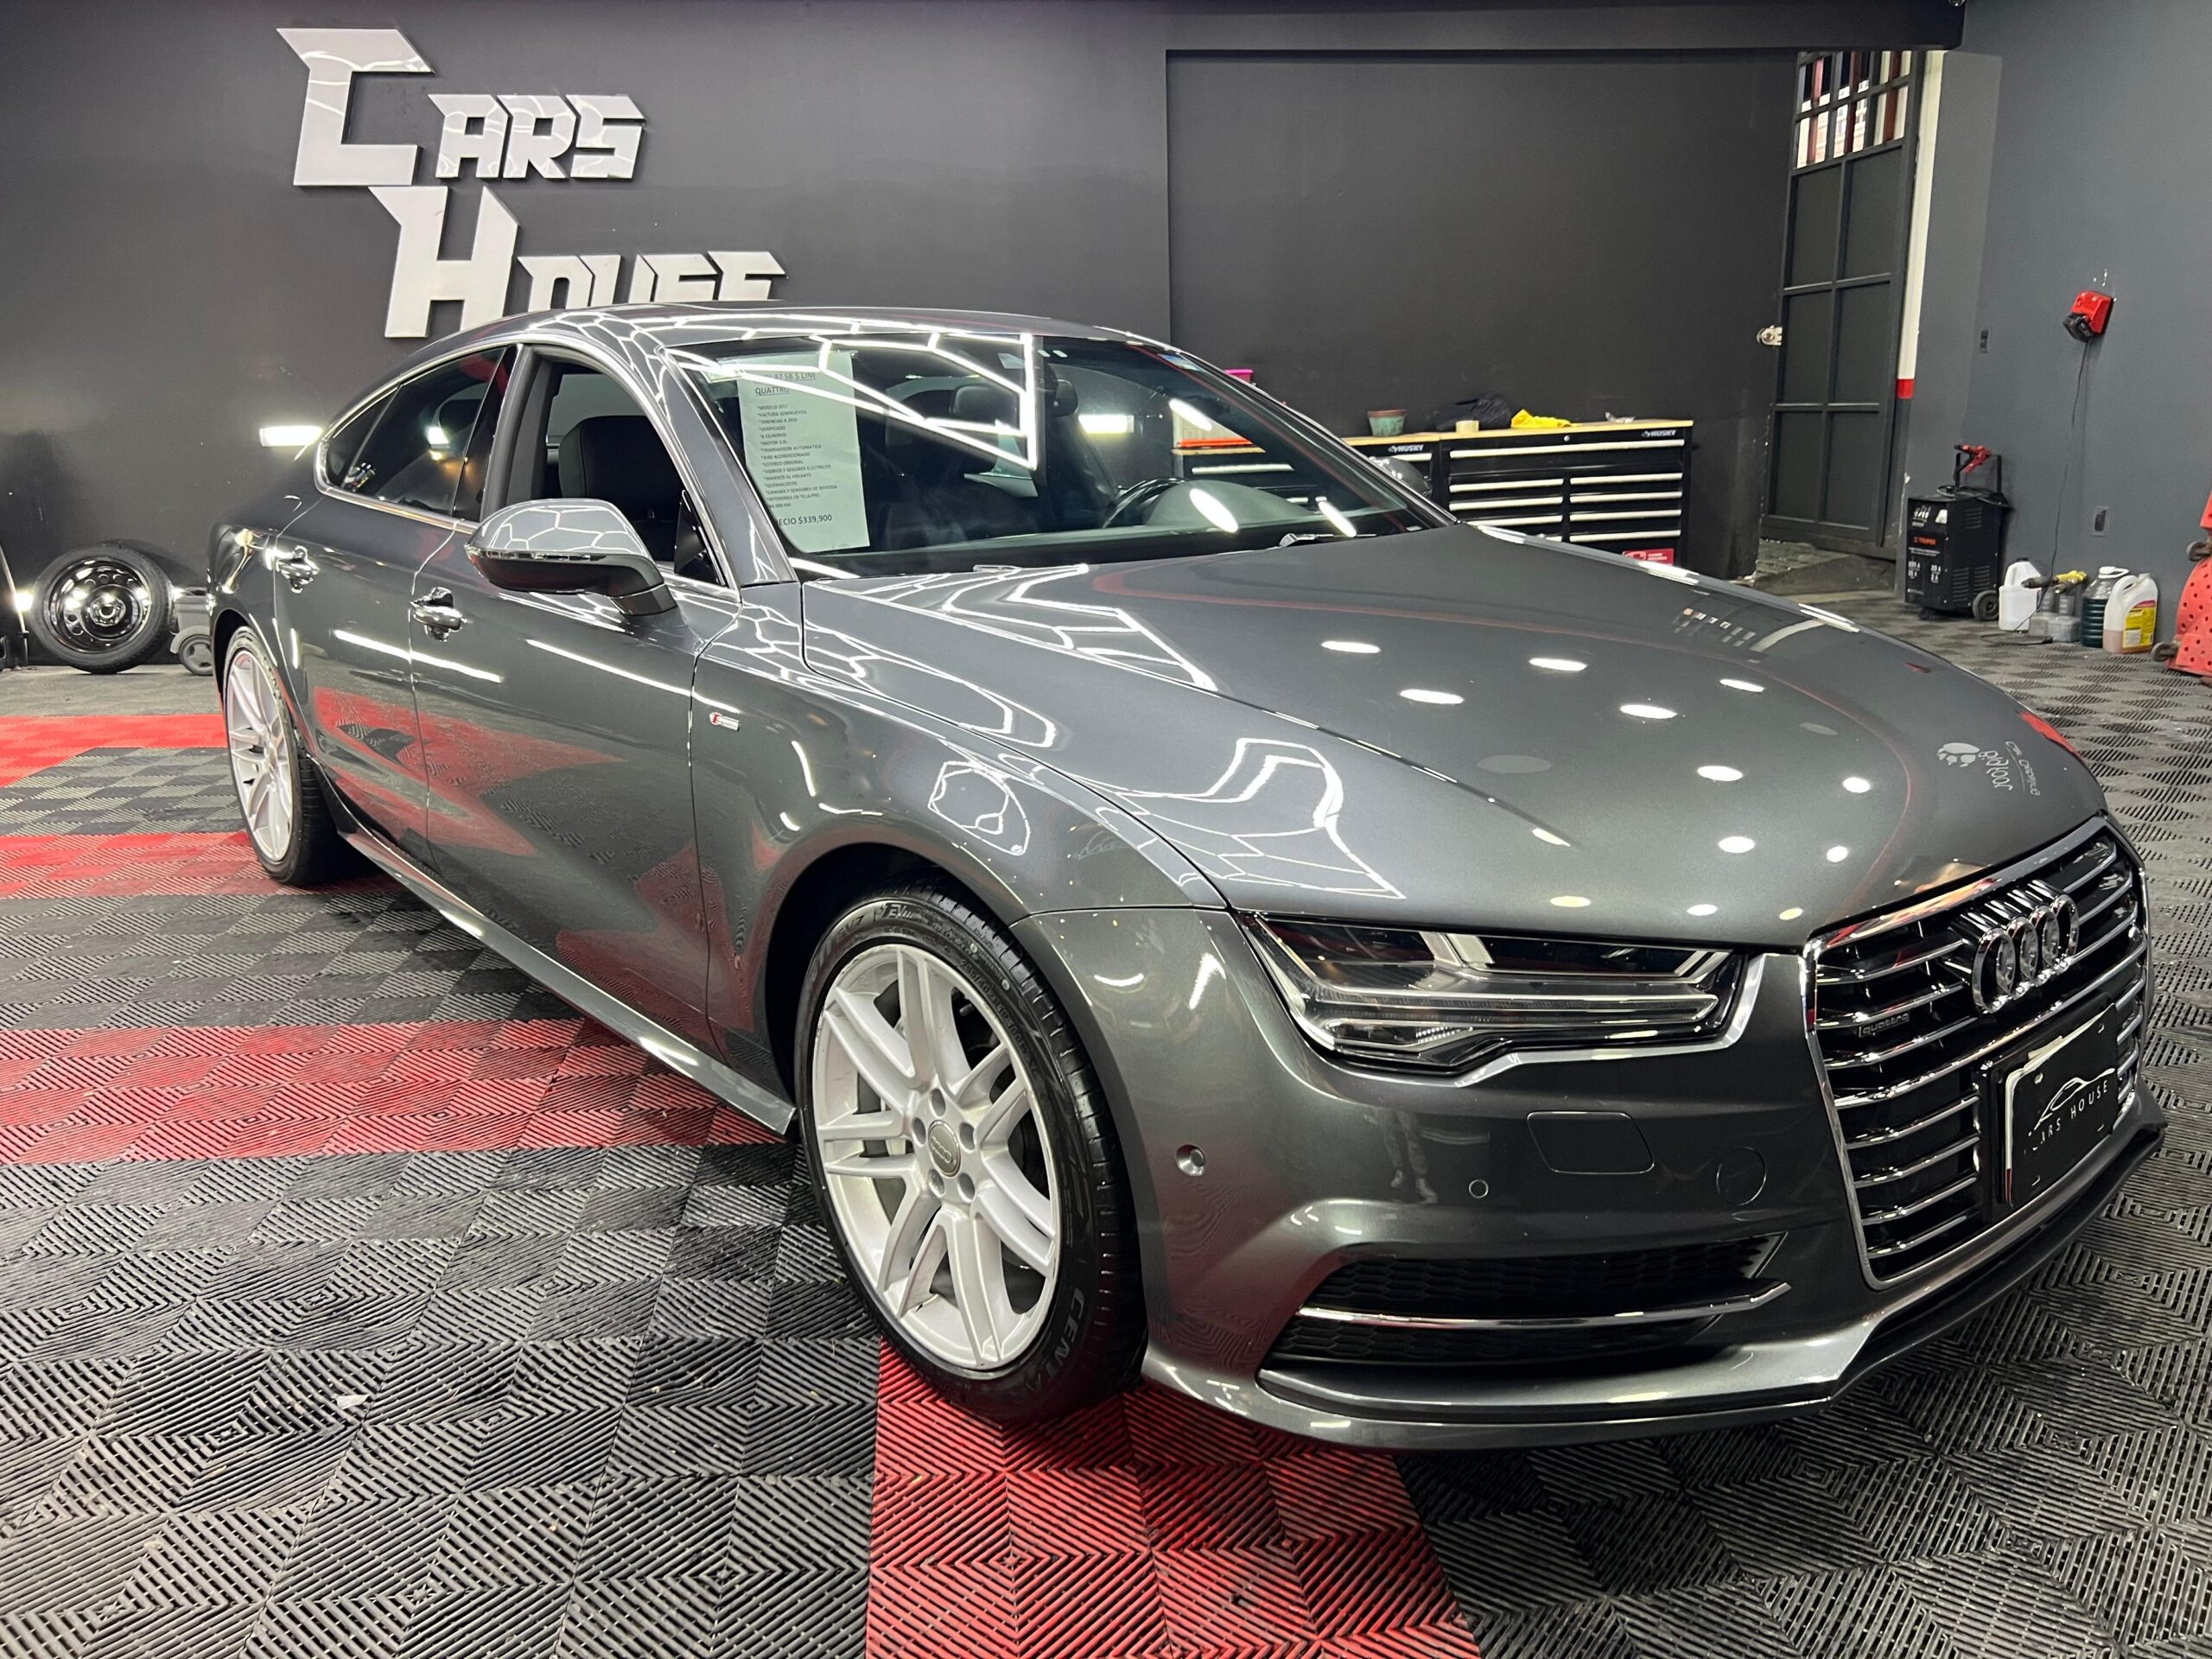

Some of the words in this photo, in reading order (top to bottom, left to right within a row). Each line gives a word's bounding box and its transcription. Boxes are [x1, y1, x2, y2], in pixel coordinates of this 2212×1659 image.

[276, 29, 645, 186] CARS
[755, 387, 790, 396] QUATTRO
[779, 517, 797, 526] ECIO
[799, 514, 833, 524] $339,900
[1862, 1013, 1909, 1035] quattro
[2032, 1118, 2061, 1150] ARS
[2071, 1080, 2107, 1119] HOUSE
